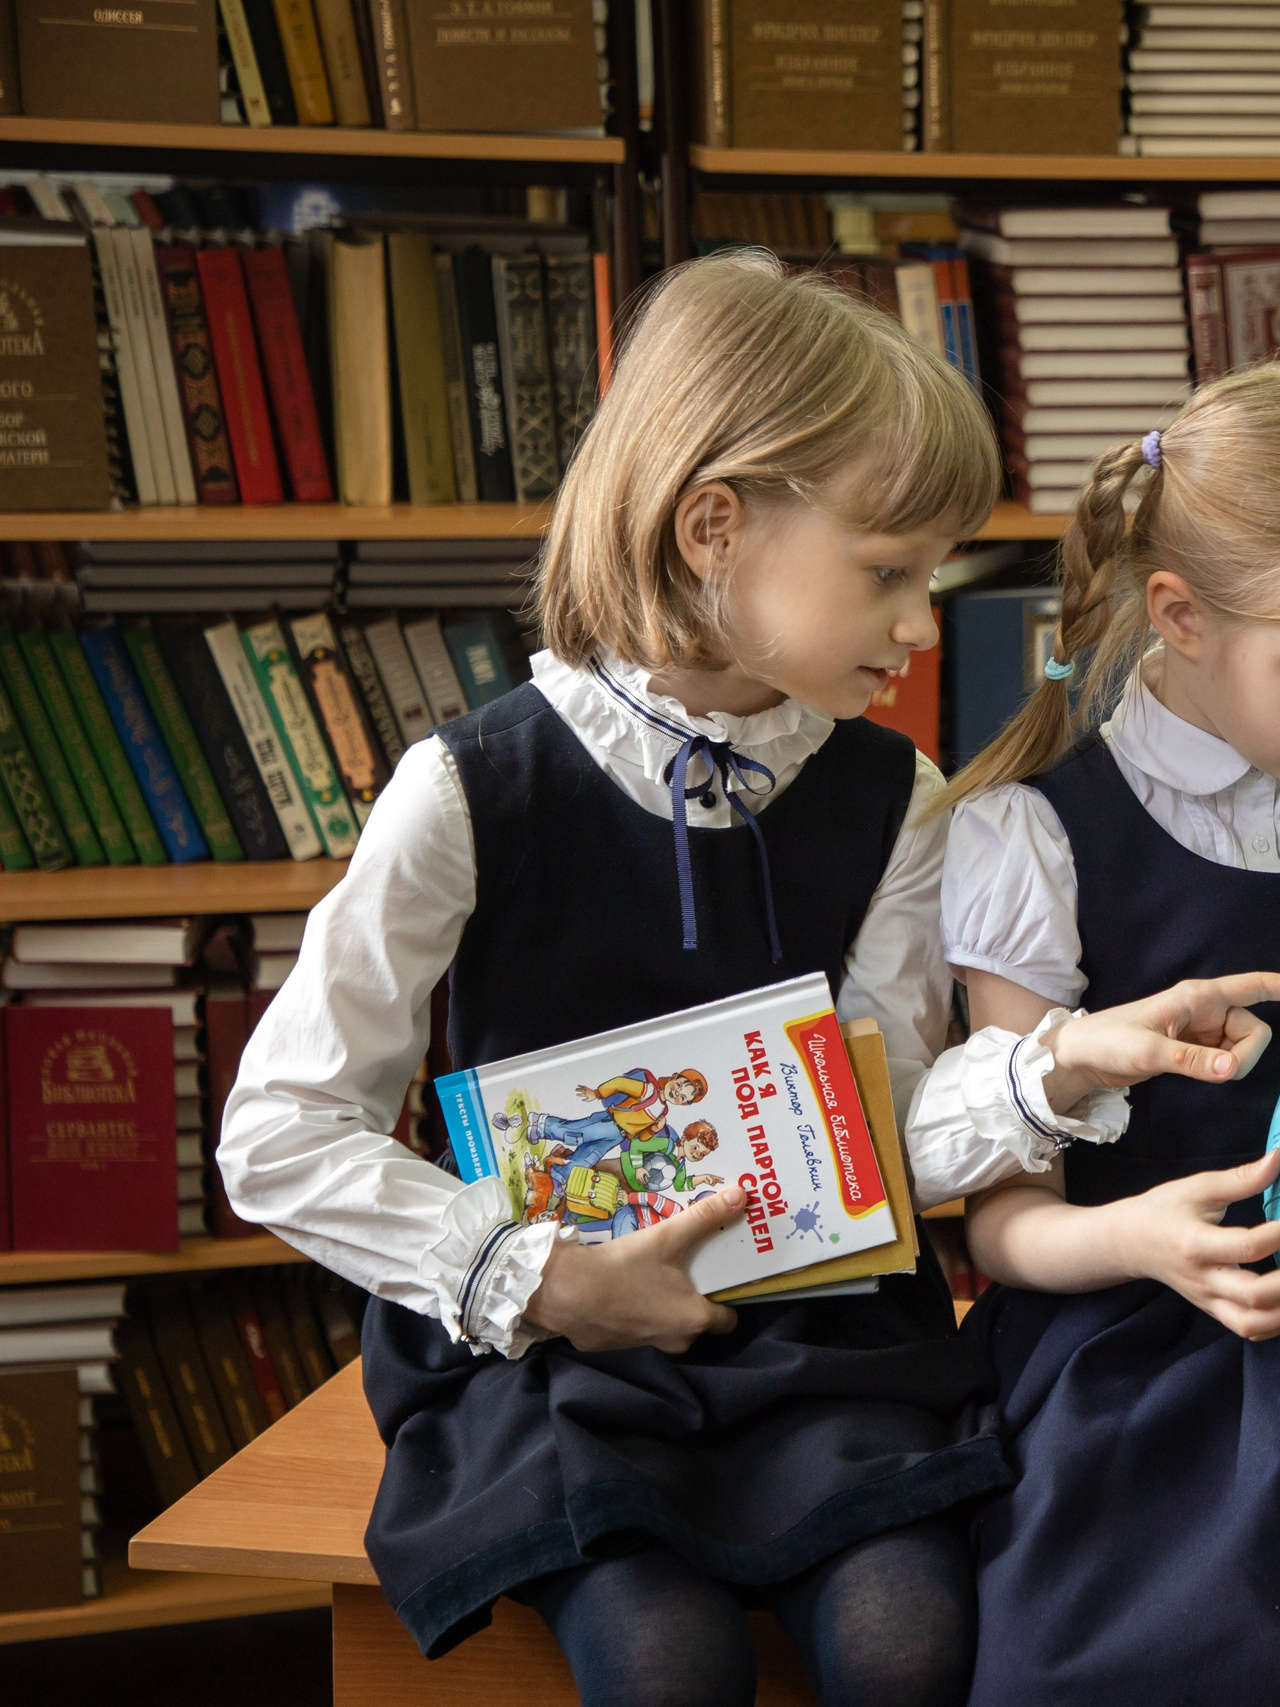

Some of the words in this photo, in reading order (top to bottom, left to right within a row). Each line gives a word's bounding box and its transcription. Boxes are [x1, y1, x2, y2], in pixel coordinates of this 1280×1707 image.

[743, 1030, 772, 1079] КАК
[760, 1082, 777, 1101] Я
[808, 1033, 838, 1110] Школьная
[830, 1114, 863, 1202] библиотека
[455, 1093, 469, 1127] ТЕКСТЫ
[465, 1130, 485, 1179] ПРОИЗВЕДЕ
[731, 1067, 759, 1121] ПОД
[747, 1124, 789, 1218] ПАРТОЙ
[780, 1062, 803, 1117] Виктор
[797, 1124, 825, 1193] Голявкин
[738, 1172, 774, 1253] СИДЕЛ
